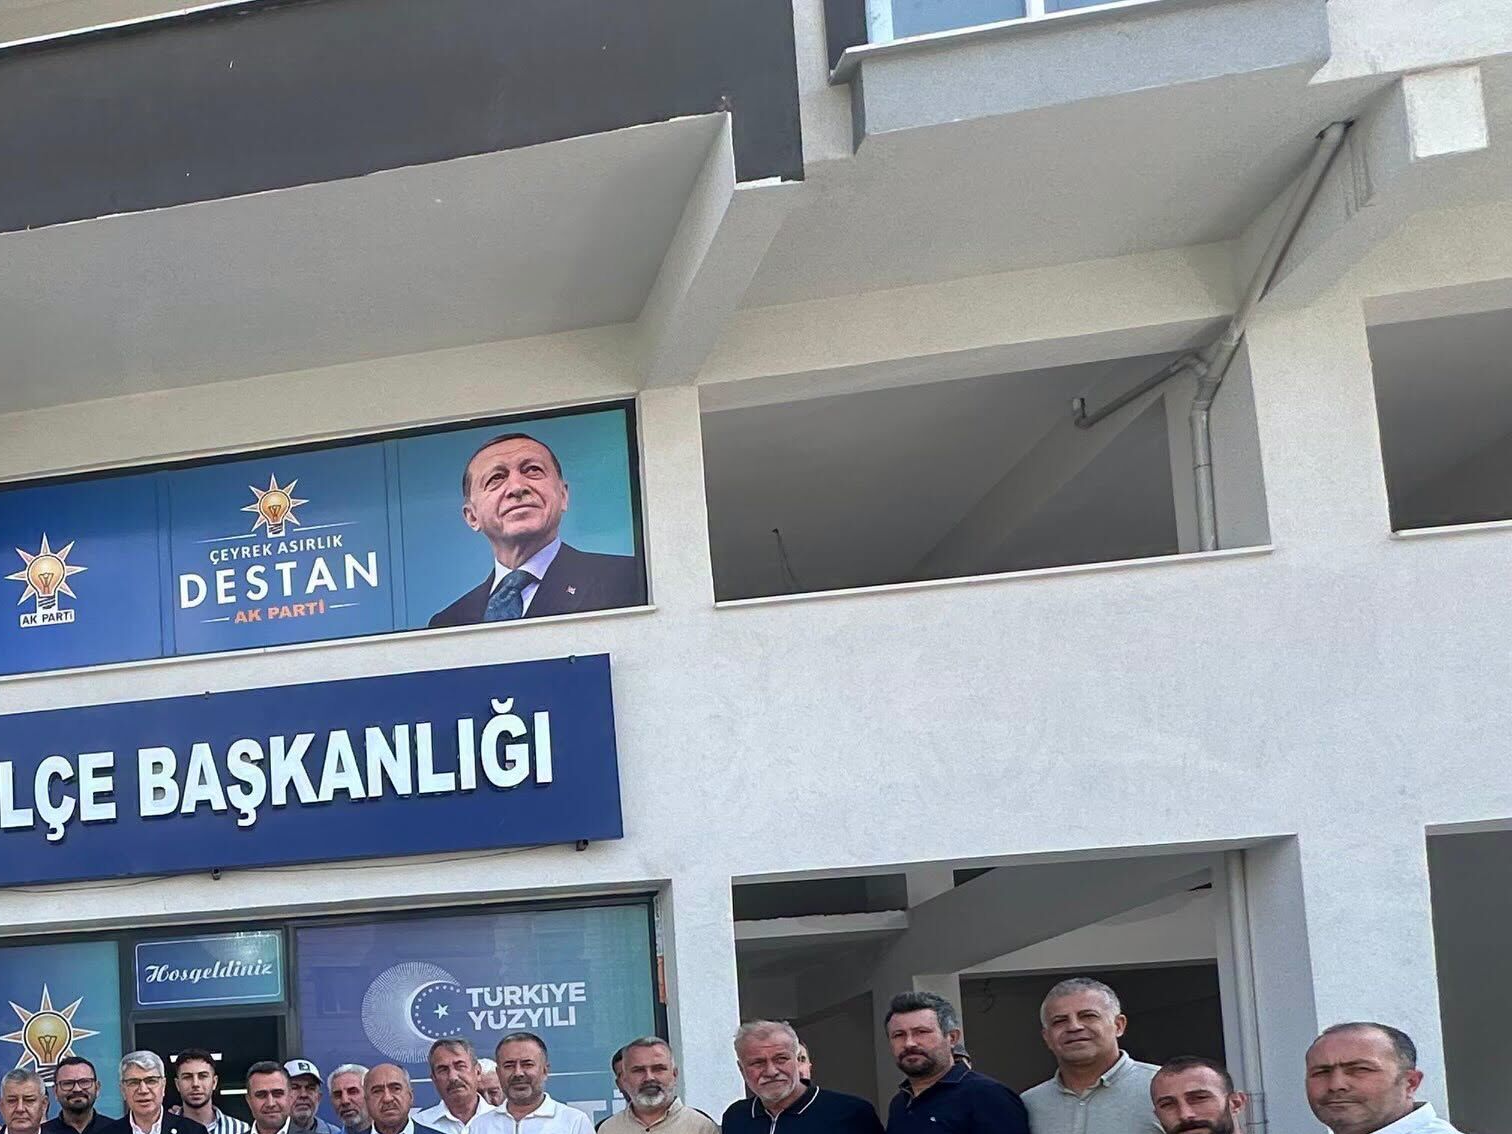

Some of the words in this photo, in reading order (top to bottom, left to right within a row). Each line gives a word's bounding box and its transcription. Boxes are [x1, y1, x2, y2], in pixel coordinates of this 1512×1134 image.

[209, 543, 273, 565] ÇEYREK
[277, 534, 343, 554] ASIRLIK
[179, 551, 379, 609] DESTAN
[22, 614, 37, 625] AK
[234, 608, 262, 624] AK
[267, 599, 325, 620] PARTİ
[137, 697, 554, 828] BAŞKANLIĞI
